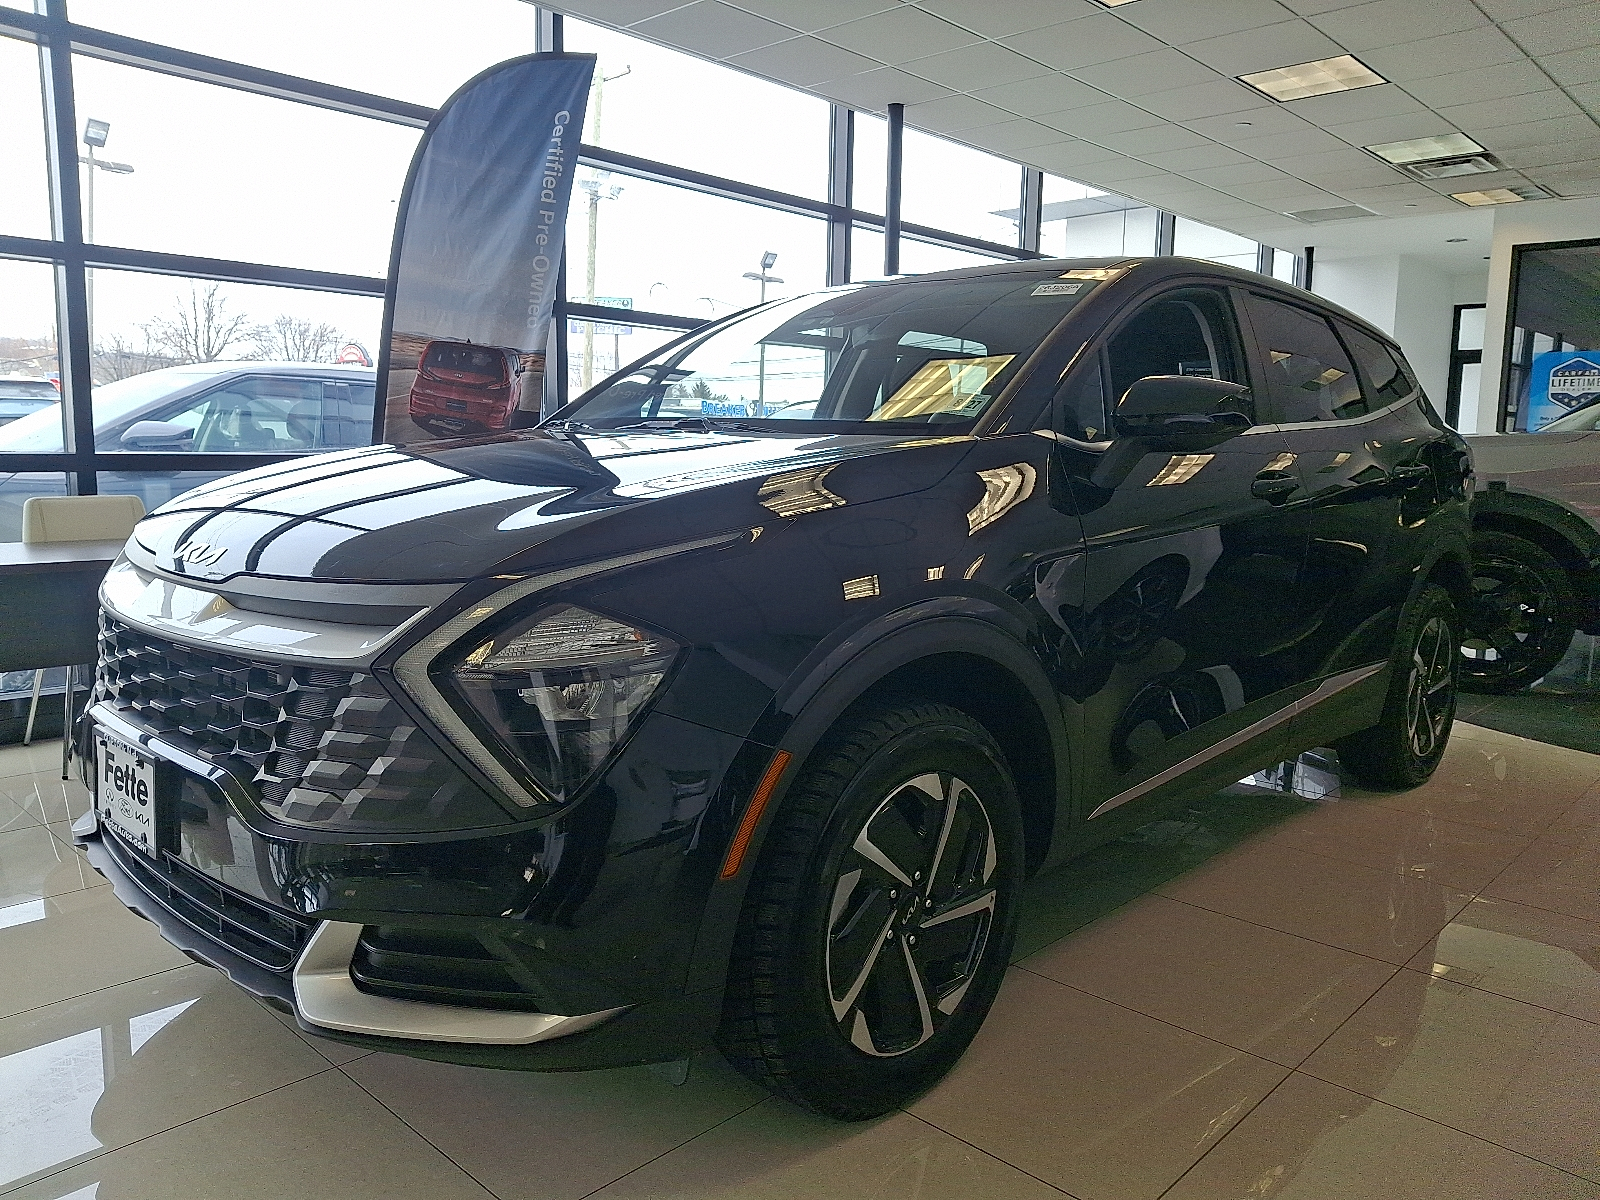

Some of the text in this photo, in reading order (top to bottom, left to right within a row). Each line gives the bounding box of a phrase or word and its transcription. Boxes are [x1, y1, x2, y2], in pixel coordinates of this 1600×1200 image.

[540, 110, 570, 204] Certified
[1551, 378, 1600, 388] LIFETIME
[701, 400, 746, 417] BREAKER
[104, 750, 149, 807] Fette
